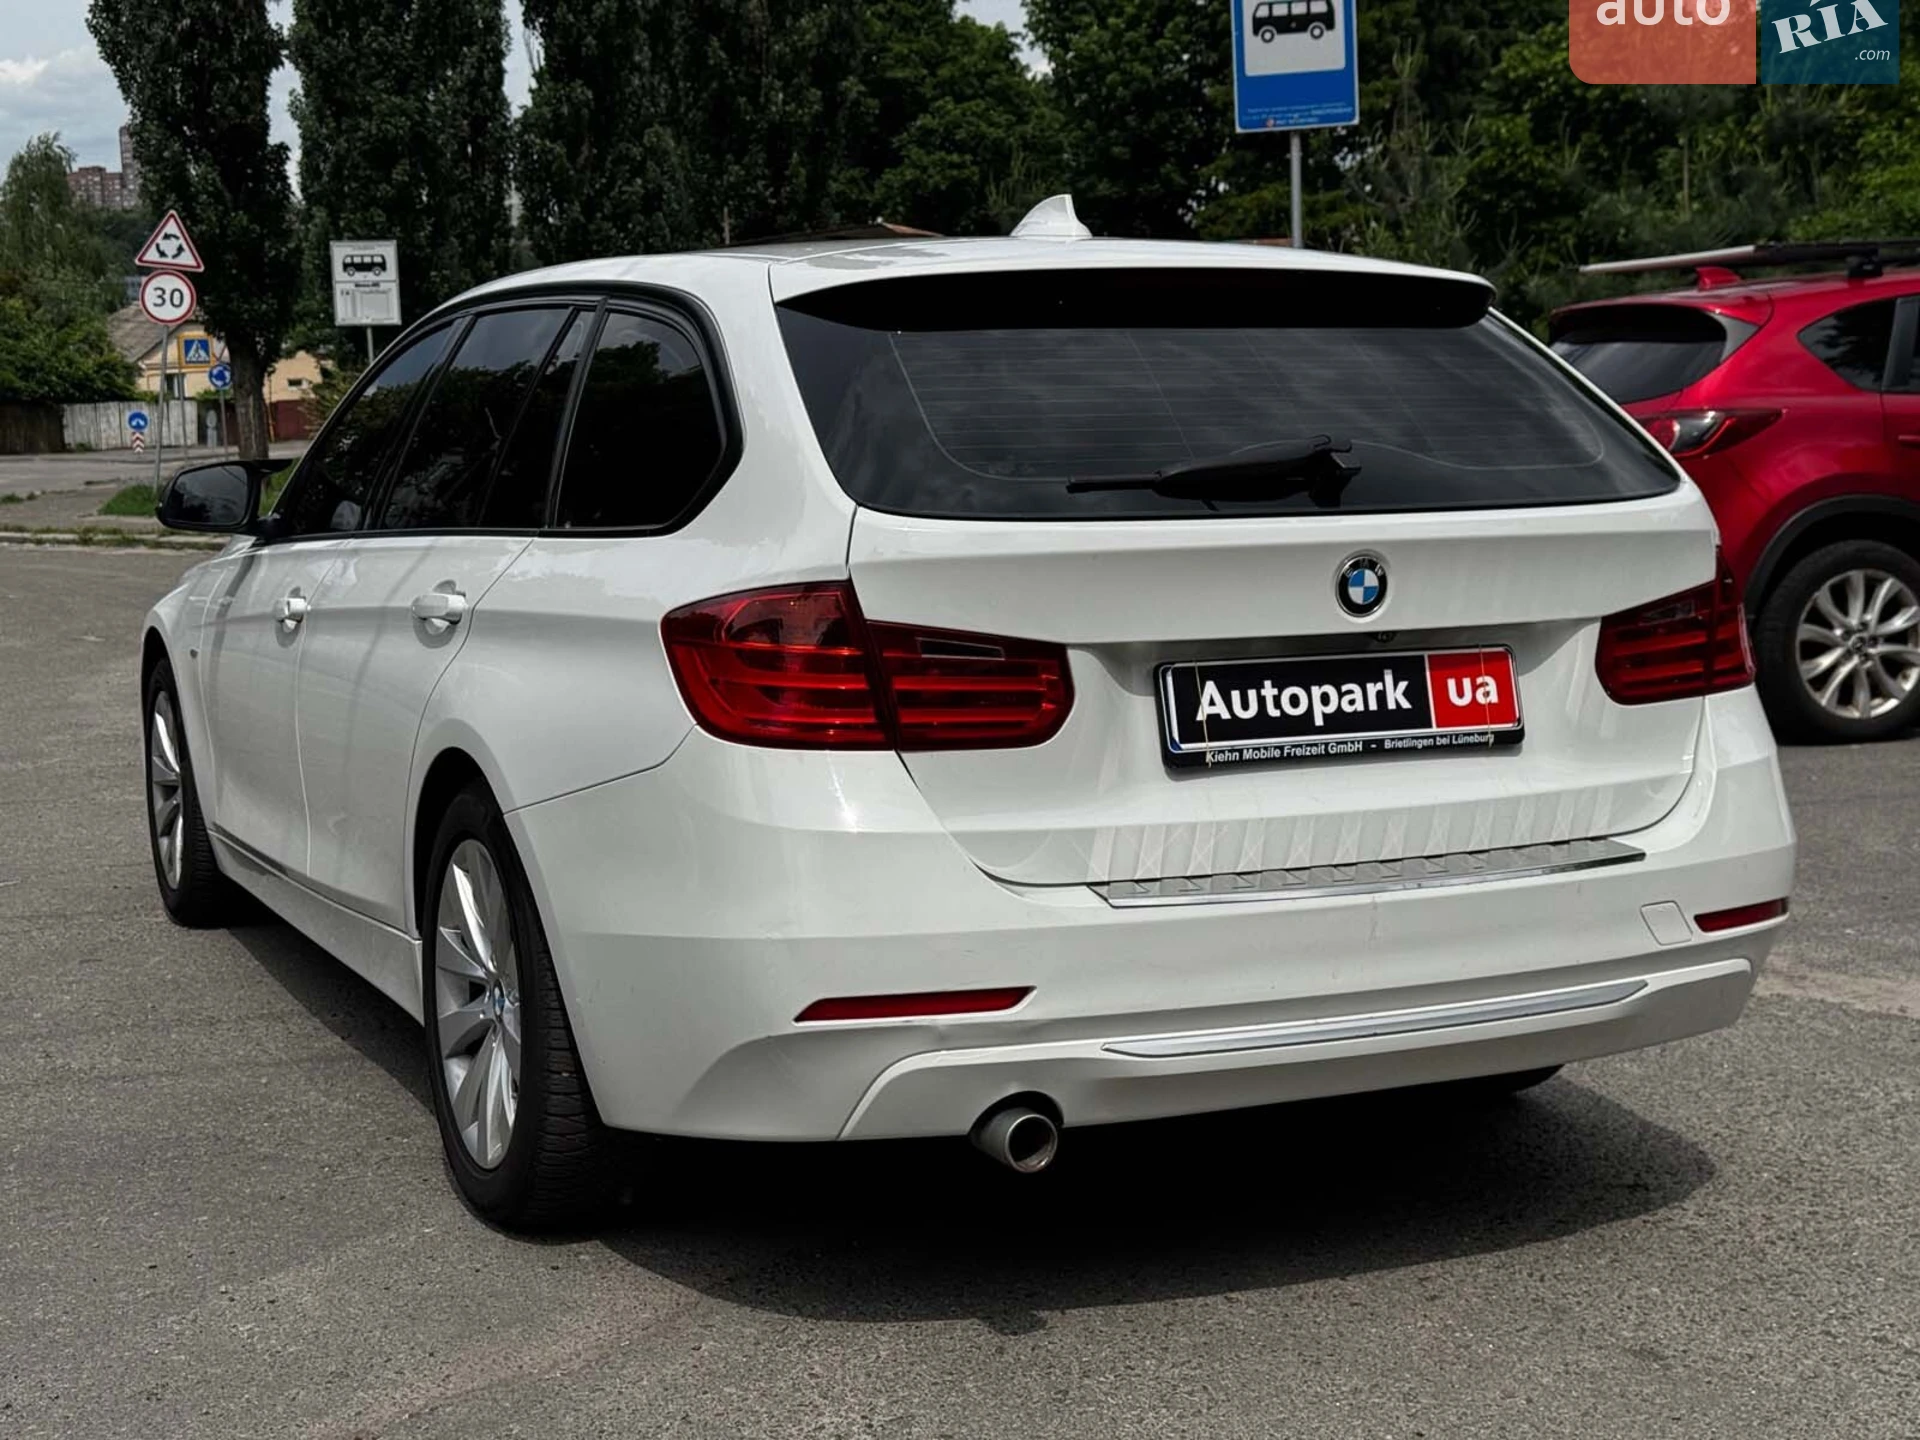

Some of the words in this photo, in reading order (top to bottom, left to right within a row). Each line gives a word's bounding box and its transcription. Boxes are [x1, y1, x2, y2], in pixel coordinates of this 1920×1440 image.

[152, 286, 185, 308] 30
[1195, 669, 1412, 726] Autopark
[1447, 675, 1499, 707] ua
[1206, 749, 1240, 763] Kiehn
[1242, 747, 1281, 760] Mobile
[1284, 743, 1326, 757] Freizeit
[1328, 740, 1363, 754] GmbH
[1384, 737, 1434, 749] Brietlingen
[1436, 735, 1451, 746] bei
